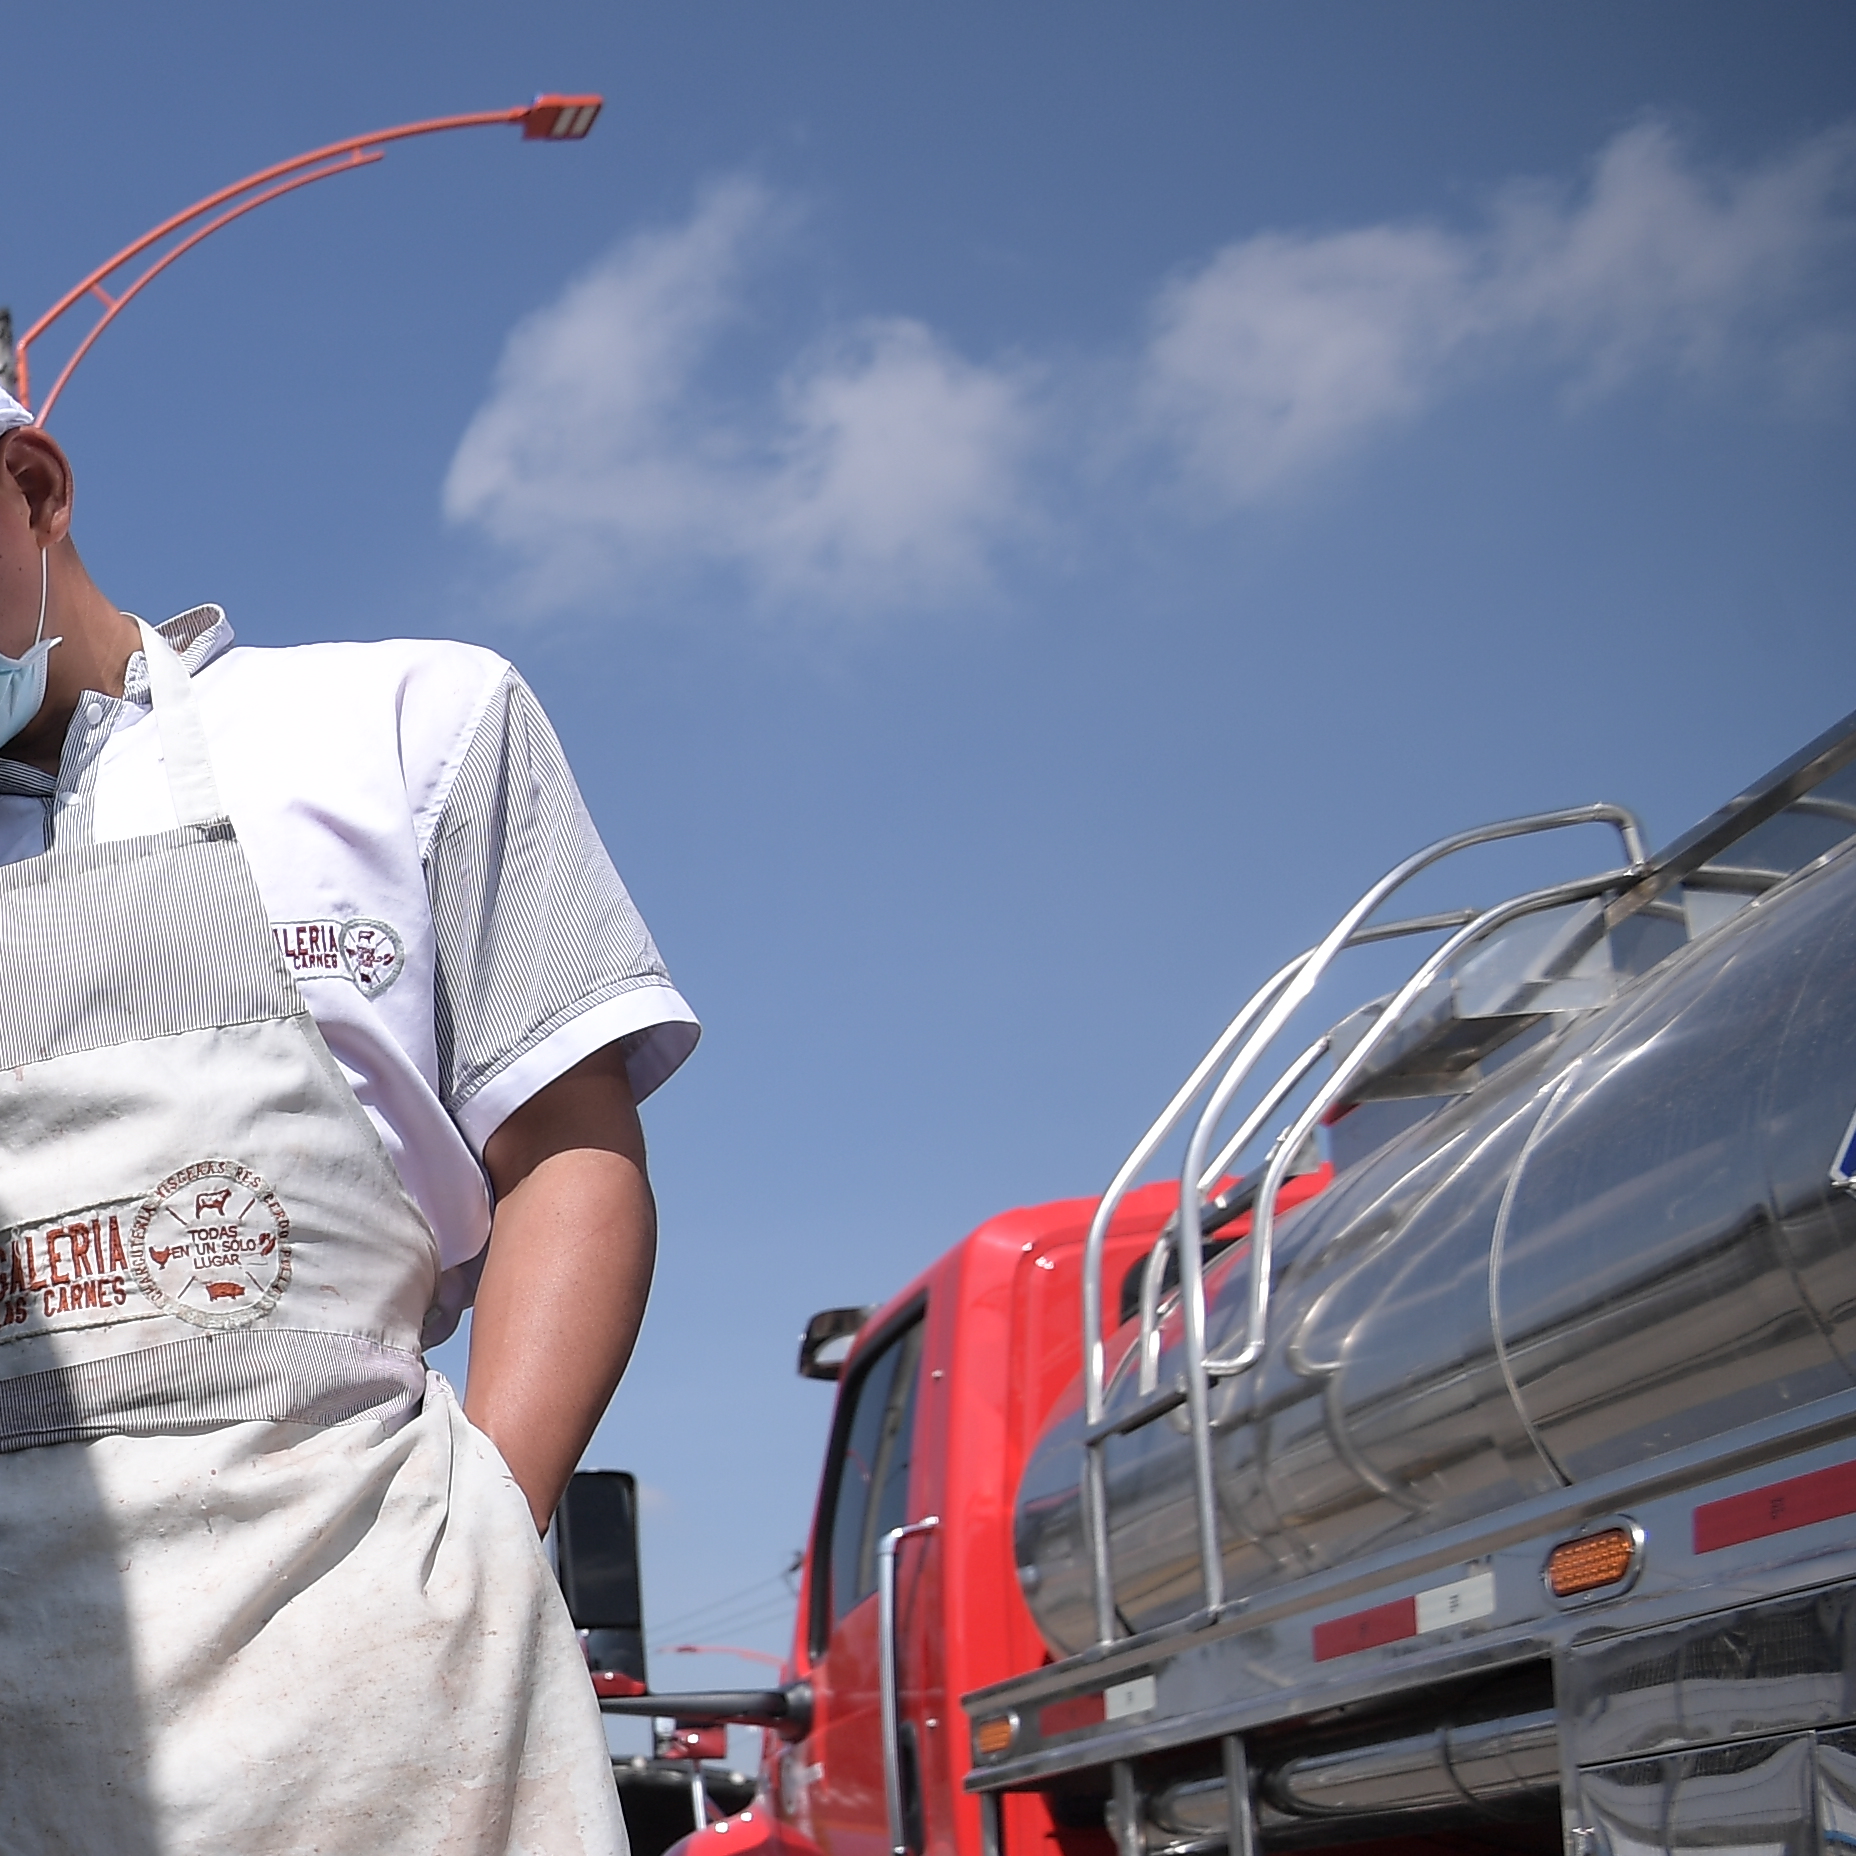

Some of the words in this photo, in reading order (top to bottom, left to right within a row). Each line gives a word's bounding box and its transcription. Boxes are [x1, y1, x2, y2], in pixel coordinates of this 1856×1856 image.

[293, 953, 338, 970] CARNES
[235, 1165, 261, 1189] RES
[263, 1192, 291, 1239] CERDO
[186, 1225, 239, 1242] TODAS
[171, 1245, 190, 1259] EN
[196, 1242, 216, 1256] UN
[221, 1239, 257, 1252] SOLO
[193, 1254, 242, 1270] LUGAR
[43, 1275, 128, 1318] CARNES
